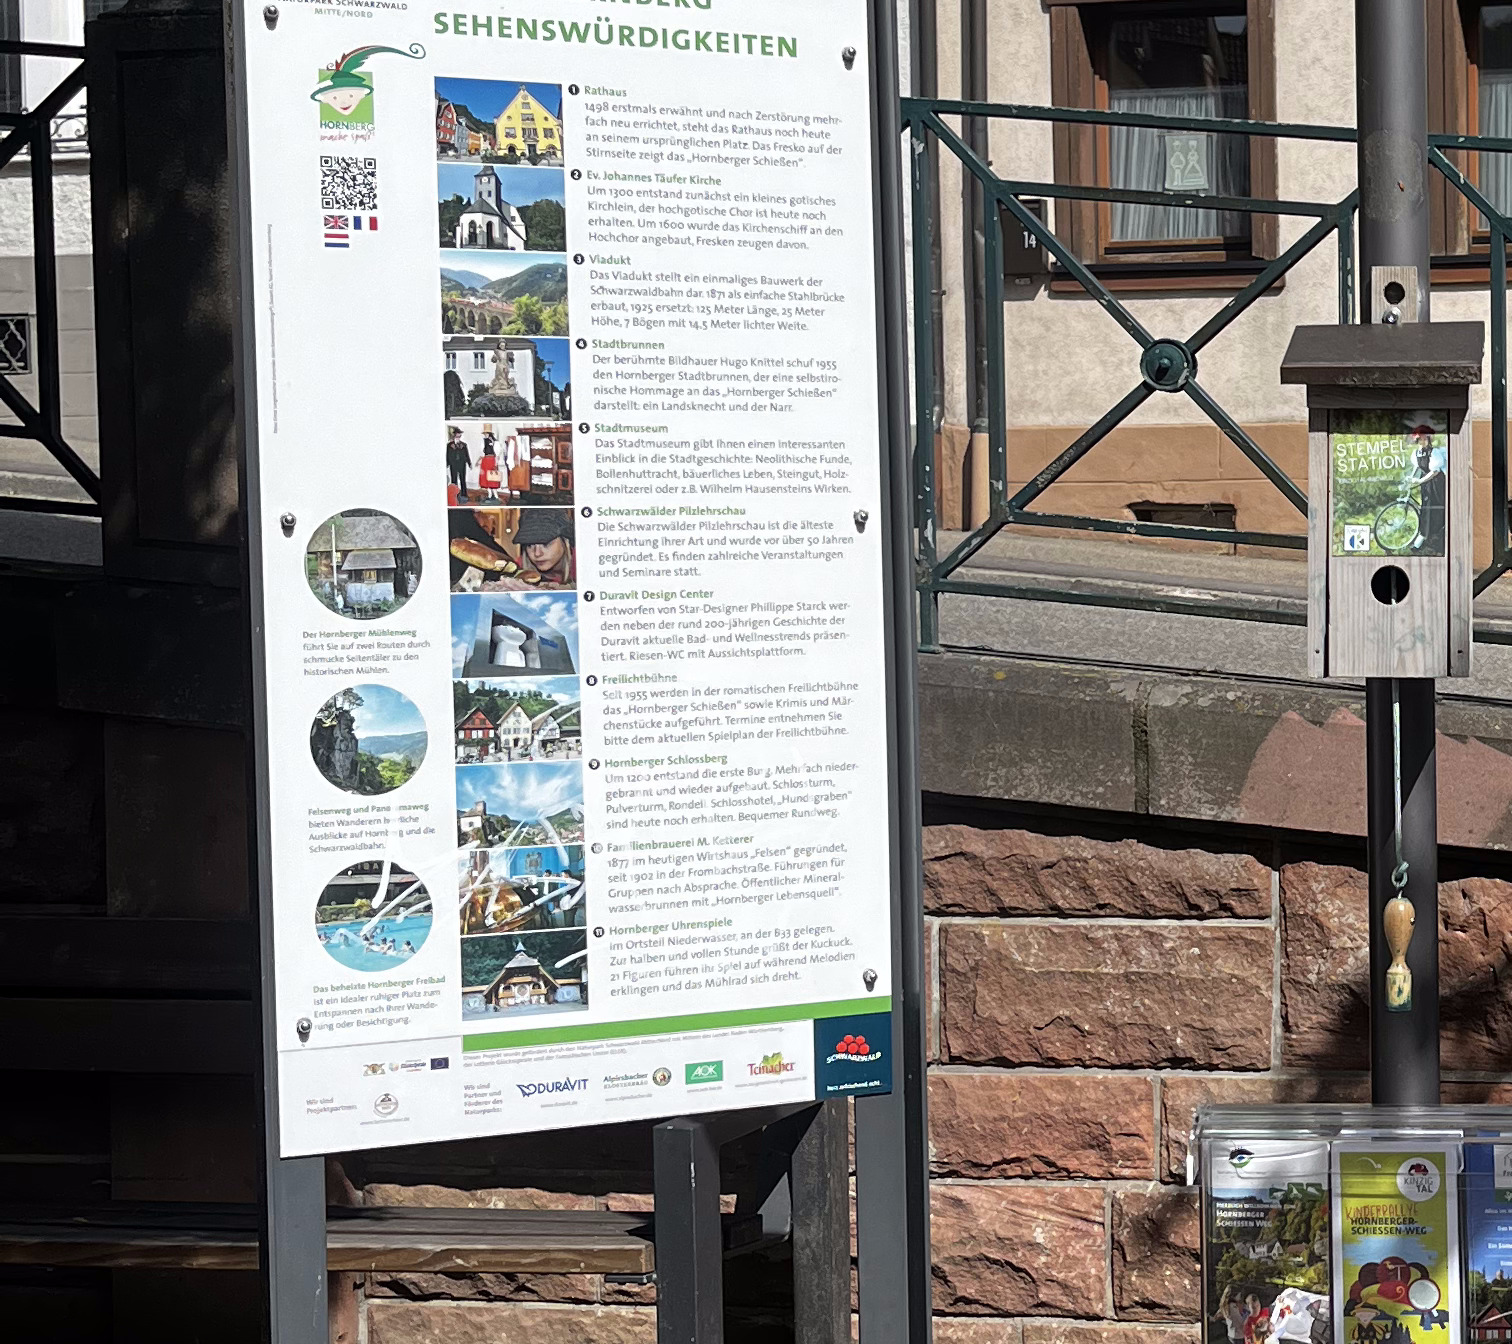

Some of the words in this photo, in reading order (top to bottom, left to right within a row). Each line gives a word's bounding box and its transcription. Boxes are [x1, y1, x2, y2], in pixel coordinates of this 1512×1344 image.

[314, 7, 373, 19] MITTE/NORD
[434, 12, 797, 58] SEHENSWÜRDIGKEITEN
[584, 85, 627, 97] Rathaus
[584, 100, 609, 113] 1498
[611, 101, 656, 114] erstmals
[659, 104, 702, 117] erwähnt
[706, 107, 725, 118] und
[728, 108, 752, 120] nach
[755, 110, 810, 125] Zerstörung
[812, 114, 842, 125] mehr-
[320, 120, 376, 132] HORNBERG
[587, 169, 600, 180] Ev.
[603, 170, 652, 182] Johannes
[654, 172, 687, 184] Täufer
[689, 174, 721, 186] Kirche
[587, 185, 606, 195] Um
[608, 188, 633, 199] 1300
[635, 187, 682, 199] entstand
[685, 189, 730, 201] zunächst
[733, 192, 749, 202] ein
[752, 192, 786, 204] kleines
[789, 194, 836, 208] gotisches
[589, 254, 631, 266] Viadukt
[591, 338, 664, 349] Stadtbrunnen
[592, 354, 611, 364] Der
[614, 354, 665, 365] berühmte
[668, 355, 717, 366] Bildhauer
[720, 357, 748, 369] Hugo
[750, 356, 783, 367] Knittel
[786, 357, 814, 367] schuf
[816, 360, 836, 370] 1955
[594, 422, 668, 433] Stadtmuseum
[595, 438, 614, 448] Das
[617, 438, 690, 448] Stadtmuseum
[693, 438, 712, 450] gibt
[716, 438, 745, 448] Ihnen
[747, 439, 775, 448] einen
[778, 439, 845, 449] interessanten
[1336, 439, 1408, 458] STEMPEL
[1337, 456, 1406, 473] STATION
[597, 506, 675, 516] Schwarzwälder
[679, 505, 745, 516] Pilzlehrschau
[599, 589, 638, 600] Duravit
[641, 589, 677, 602] Design
[679, 588, 714, 598] Center
[319, 630, 366, 639] Hornberger
[602, 672, 677, 684] Freilichtbühne
[604, 755, 664, 770] Hornberger
[667, 752, 727, 767] Schlossberg
[609, 921, 669, 937] Hornberger
[671, 916, 732, 933] Uhrenspiele
[692, 1064, 717, 1077] AOK
[537, 1077, 589, 1094] DURAVIT
[1403, 1176, 1434, 1186] KINZIG
[1416, 1184, 1433, 1193] TAL
[1216, 1208, 1265, 1218] HORNBERGER
[1350, 1216, 1418, 1225] HORNBERGER-
[1351, 1226, 1427, 1235] SCHIESSEN-WEG
